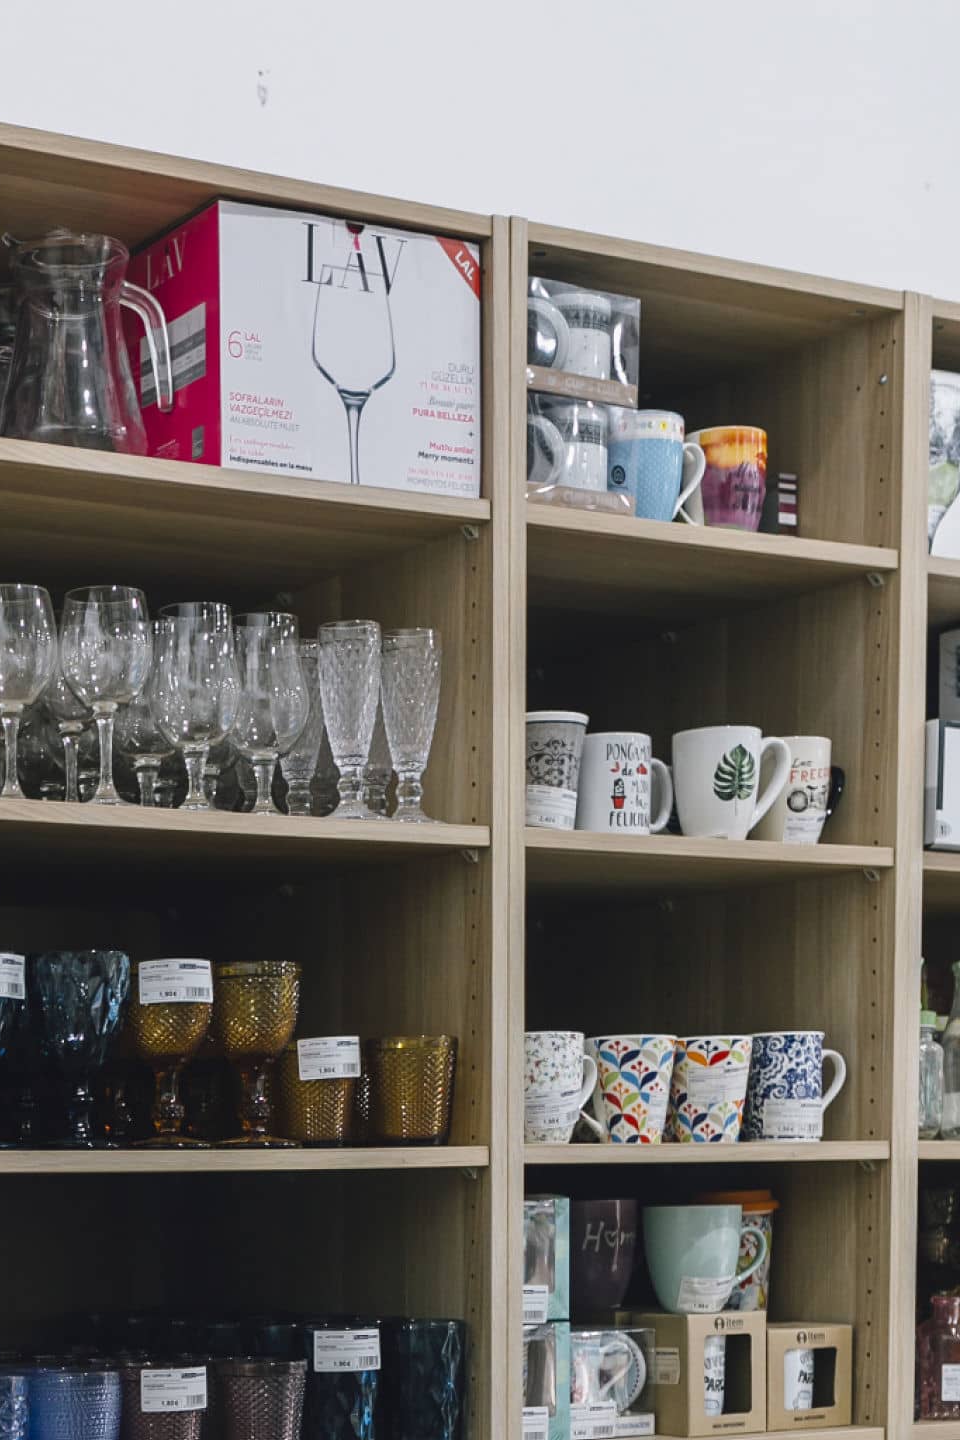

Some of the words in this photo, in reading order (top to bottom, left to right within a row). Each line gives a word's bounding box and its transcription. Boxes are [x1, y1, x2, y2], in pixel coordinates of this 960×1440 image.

[147, 232, 188, 290] LAV
[301, 220, 408, 296] LAV
[453, 249, 476, 282] LAL
[228, 330, 243, 358] 6
[412, 407, 435, 418] PURA
[437, 411, 474, 423] BELLEZA
